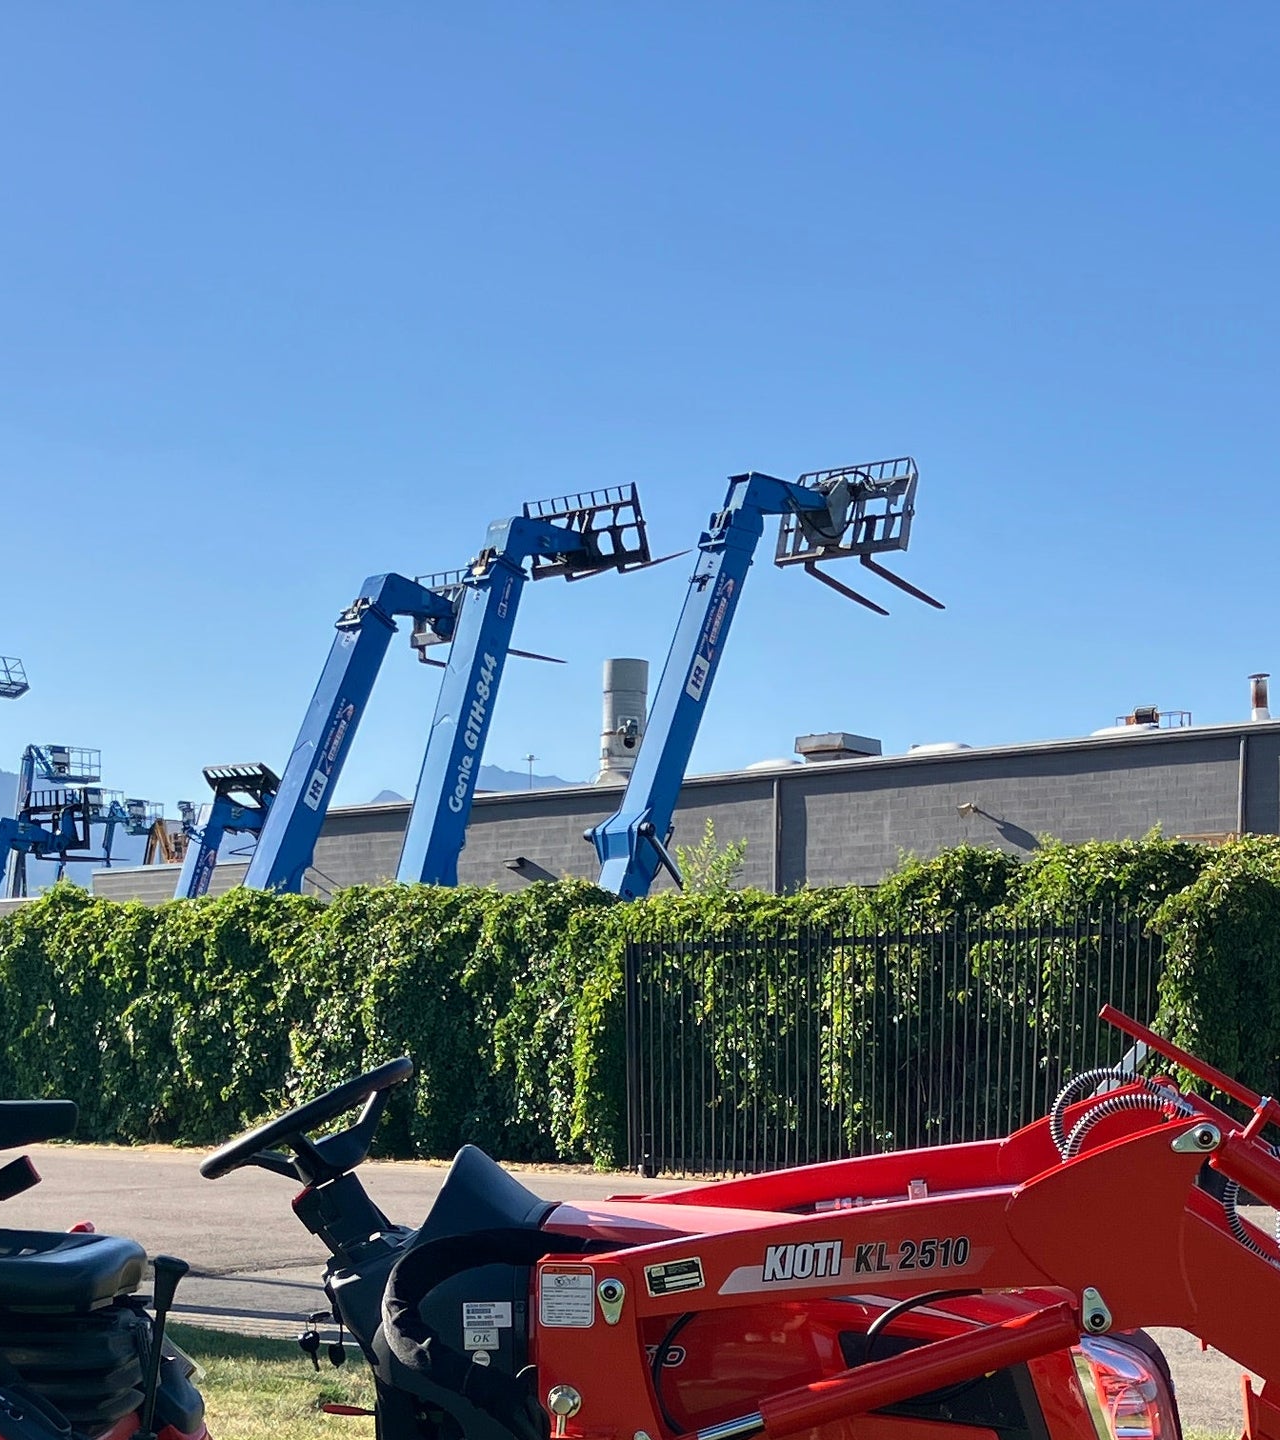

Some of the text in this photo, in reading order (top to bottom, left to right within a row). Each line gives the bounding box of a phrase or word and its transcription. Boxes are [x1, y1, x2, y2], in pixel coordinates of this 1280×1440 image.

[448, 651, 498, 813] Genie GTH-844
[762, 1236, 970, 1282] KIOTI KL 2510
[472, 1334, 491, 1343] OK
